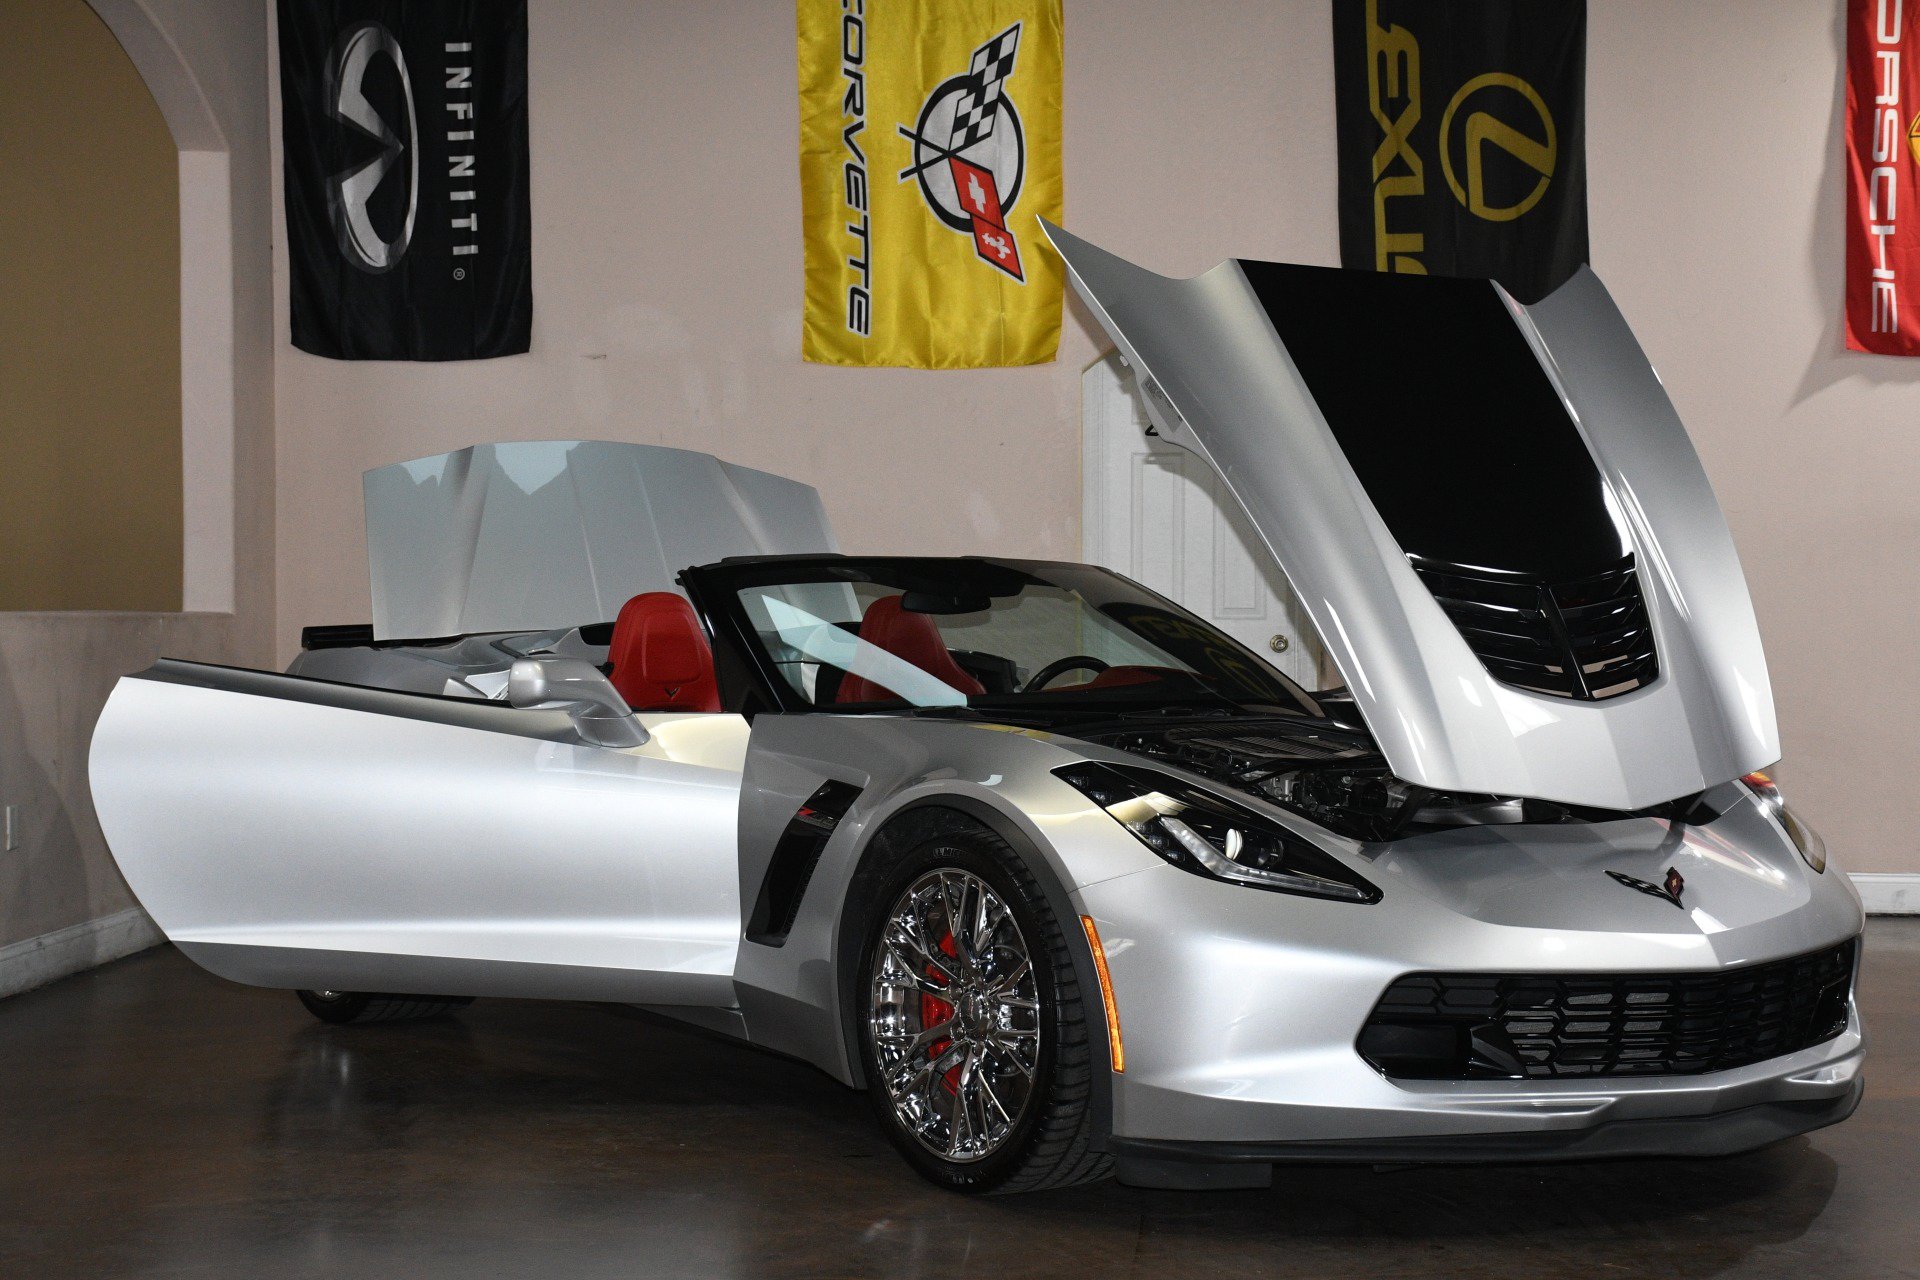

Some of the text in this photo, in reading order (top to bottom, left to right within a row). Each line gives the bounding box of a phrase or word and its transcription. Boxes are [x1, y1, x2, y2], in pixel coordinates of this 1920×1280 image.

[445, 42, 479, 256] INFINITI
[842, 0, 870, 336] ORVETTE
[1365, 0, 1428, 276] EXU
